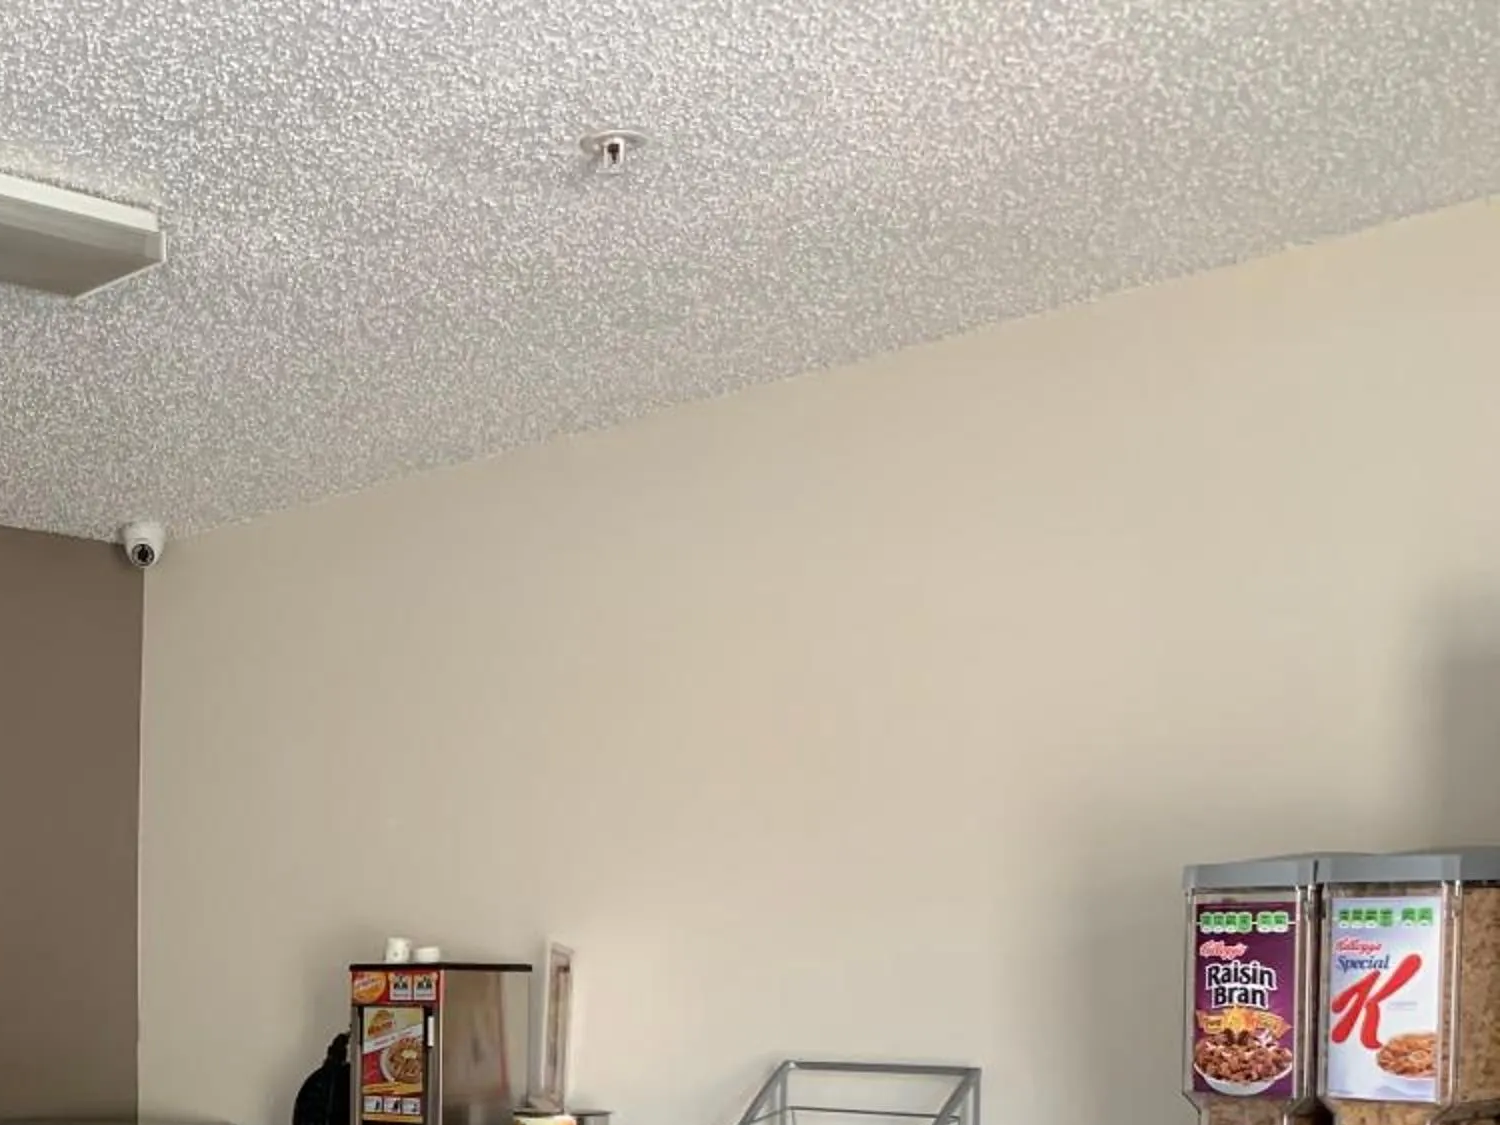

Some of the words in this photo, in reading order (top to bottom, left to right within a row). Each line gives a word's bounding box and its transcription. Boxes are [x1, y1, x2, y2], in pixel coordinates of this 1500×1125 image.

[1206, 960, 1276, 989] Raisin
[1336, 954, 1391, 974] Special
[1213, 986, 1267, 1008] Bran
[1331, 954, 1423, 1050] K
